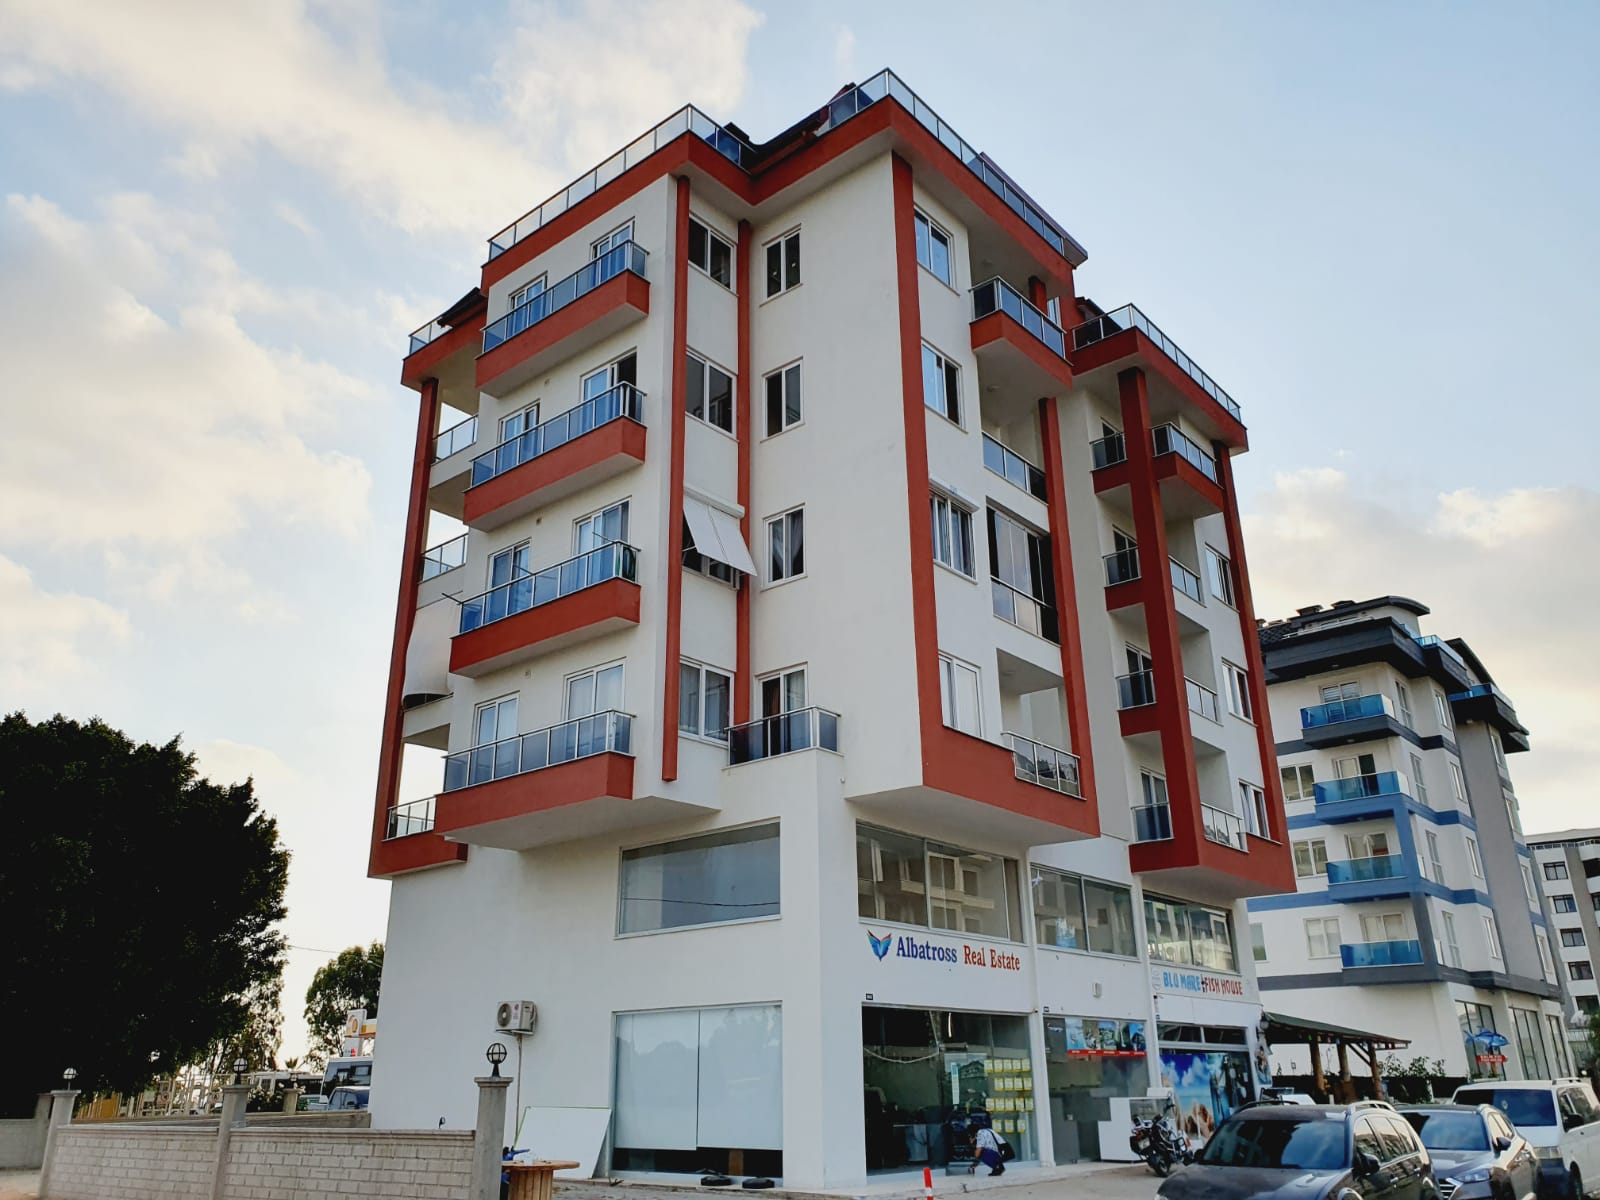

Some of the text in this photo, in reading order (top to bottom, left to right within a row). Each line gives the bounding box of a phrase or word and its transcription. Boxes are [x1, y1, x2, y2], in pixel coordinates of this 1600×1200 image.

[896, 936, 1021, 971] Albatross Real Estate
[1163, 971, 1243, 995] BLU MARE FISH HOUSE
